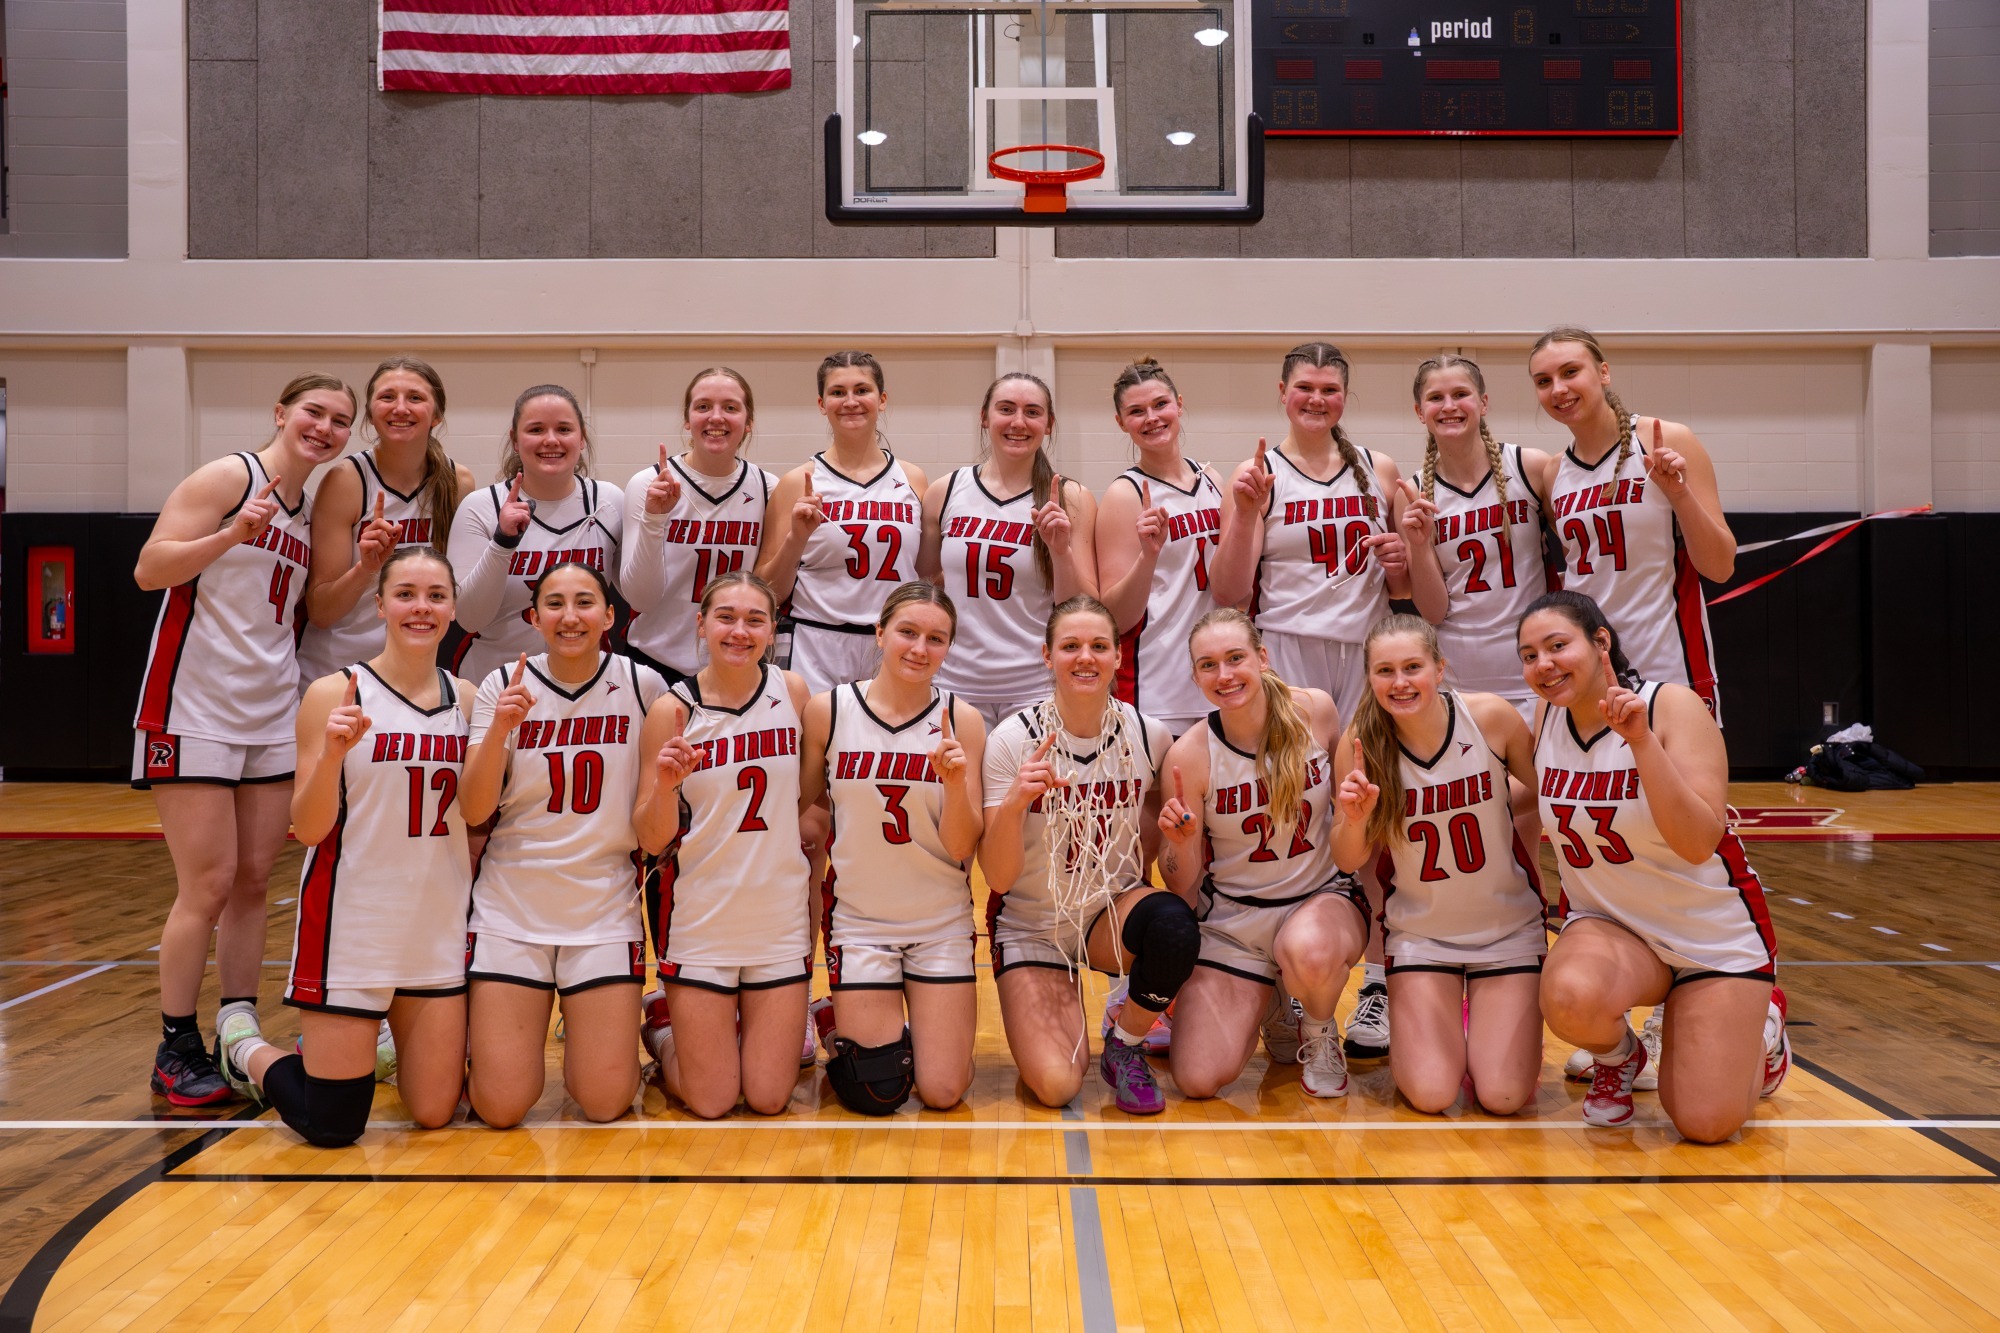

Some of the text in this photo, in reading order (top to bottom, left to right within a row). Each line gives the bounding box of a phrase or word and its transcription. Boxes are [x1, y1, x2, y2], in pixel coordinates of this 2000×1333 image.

[1431, 17, 1492, 43] period
[821, 500, 913, 524] RED HAWKS
[948, 516, 1035, 547] RED HAWK
[1168, 508, 1221, 542] RED HAW
[1284, 499, 1318, 525] RED
[1465, 499, 1528, 535] HAWKS
[240, 524, 282, 552] ED
[666, 519, 760, 546] RED HAWKS
[1307, 520, 1371, 579] 40
[1563, 510, 1627, 576] 24
[840, 524, 902, 582] 32
[965, 541, 1019, 600] 15
[1457, 531, 1517, 594] 21
[268, 560, 295, 625] 4
[372, 733, 469, 763] RED HAWK
[517, 715, 630, 749] RED HAWKS
[733, 727, 796, 763] HAWKS
[543, 750, 604, 814] 10
[836, 751, 943, 784] RED HAWK
[1541, 767, 1639, 800] RED HAWKS
[404, 766, 458, 837] 12
[737, 765, 769, 833] 2
[1216, 782, 1252, 814] RED
[1422, 770, 1493, 815] HAWKS
[875, 784, 913, 845] 3
[1241, 799, 1315, 862] 22
[1408, 812, 1486, 882] 20
[1550, 803, 1634, 869] 33
